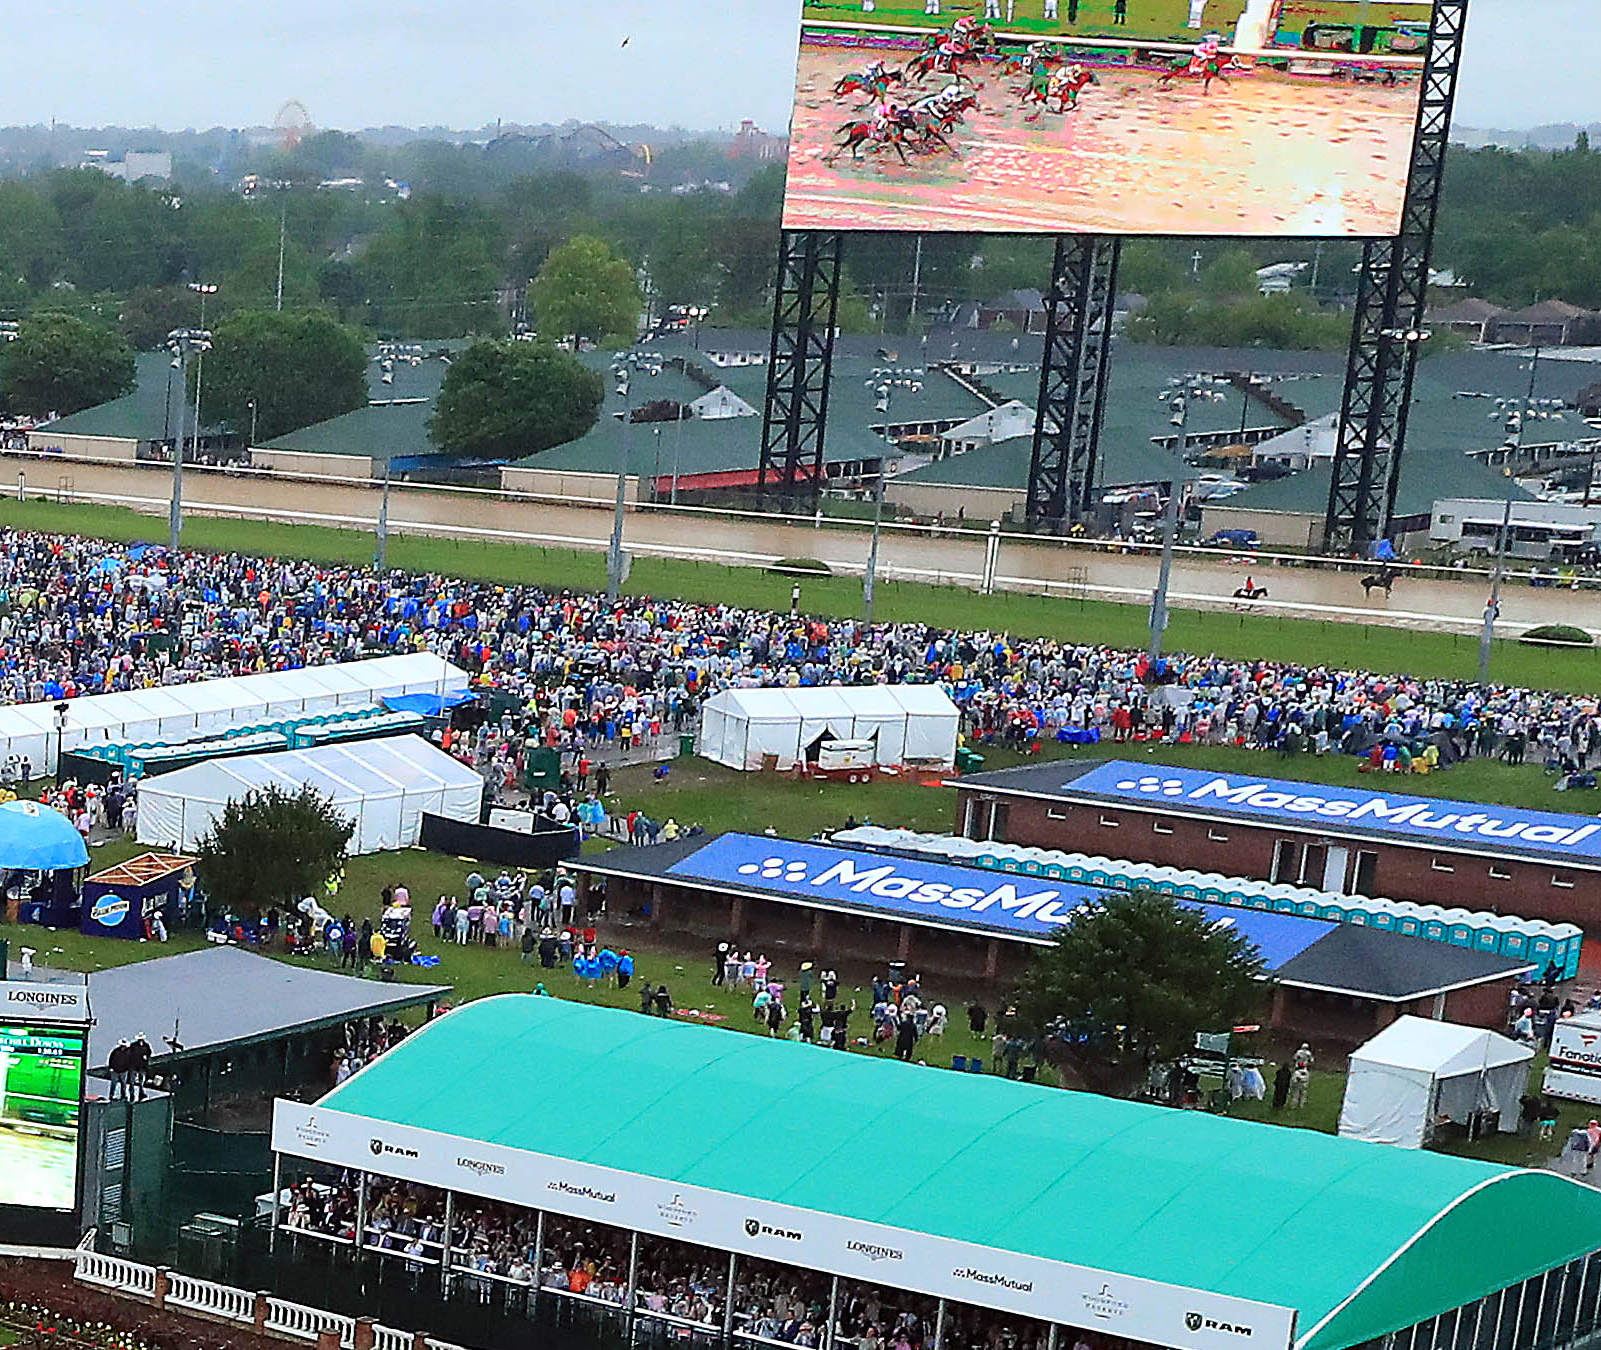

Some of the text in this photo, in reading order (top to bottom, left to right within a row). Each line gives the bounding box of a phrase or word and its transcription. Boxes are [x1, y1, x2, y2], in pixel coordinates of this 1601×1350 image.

[1188, 778, 1600, 846] MassMutual
[811, 860, 1236, 931] MassMul
[8, 991, 78, 1006] LONGINES
[384, 1145, 420, 1158] RAM
[457, 1157, 505, 1175] LONGINES
[558, 1181, 616, 1202] MassMutual
[762, 1226, 802, 1241] RAM
[847, 1240, 903, 1260] LONGINES
[967, 1268, 1033, 1292] MassMutual
[1205, 1319, 1252, 1336] RAM
